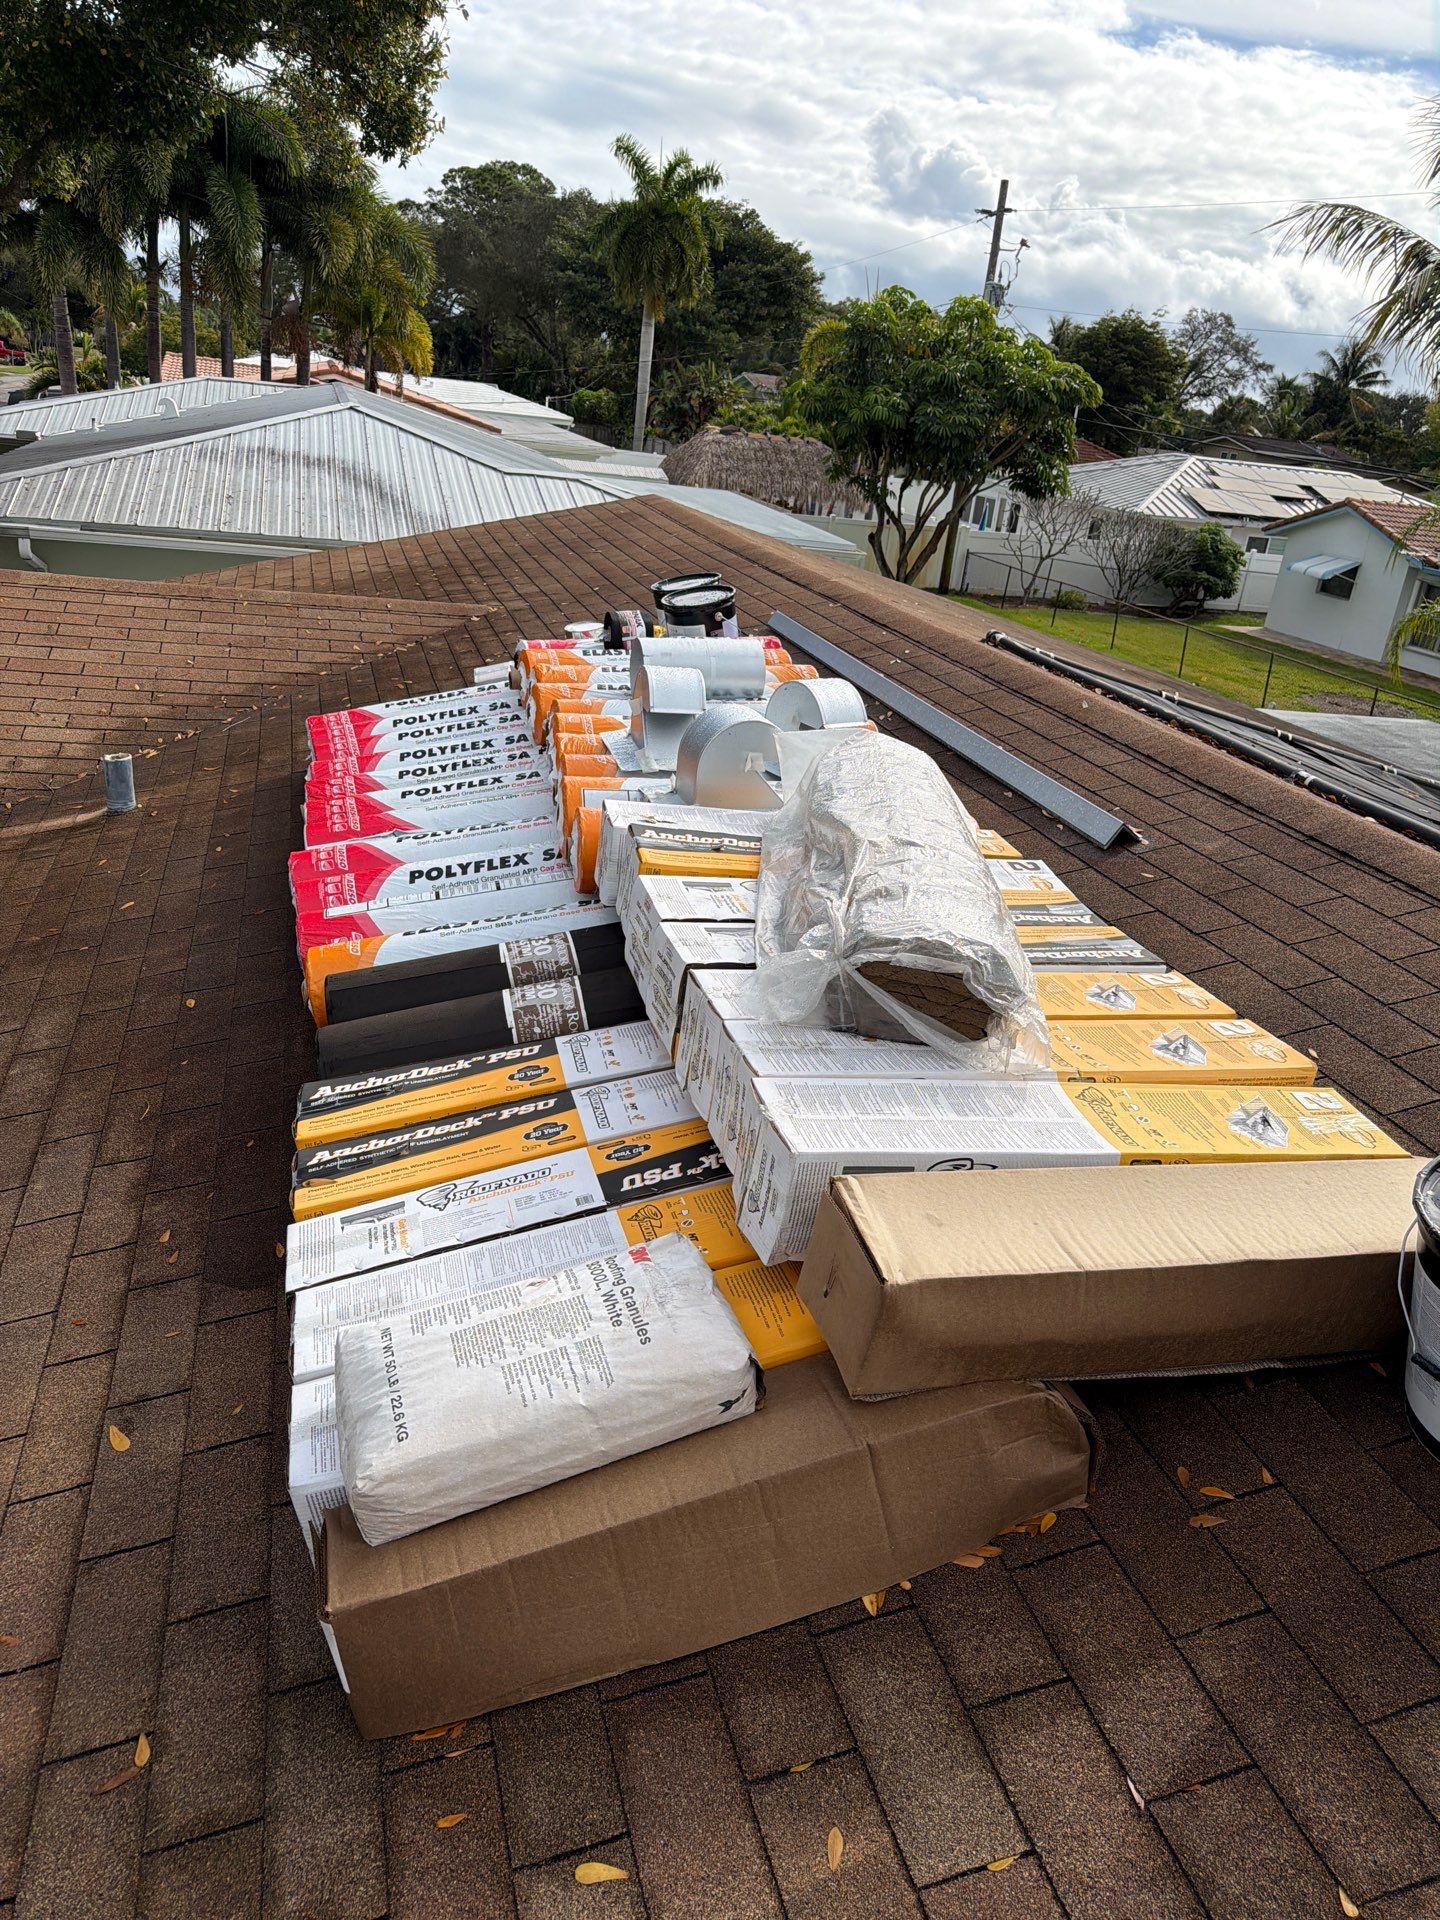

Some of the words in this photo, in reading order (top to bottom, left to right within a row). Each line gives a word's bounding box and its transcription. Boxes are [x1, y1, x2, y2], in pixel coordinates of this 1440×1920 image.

[393, 705, 479, 727] POLYFLEX
[489, 702, 511, 712] SA
[398, 719, 489, 740] POLYFLEX
[498, 713, 522, 723] SA
[399, 738, 494, 762] POLYFLEX
[505, 733, 529, 745] SA
[398, 756, 496, 779] POLYFLEX
[507, 751, 530, 761] SA
[401, 776, 503, 799] POLYFLEX
[515, 771, 541, 781] SA
[409, 852, 530, 884] POLYFLEX
[480, 871, 520, 885] Granulated
[522, 868, 538, 876] APP
[487, 1045, 542, 1064] PSU
[411, 1073, 459, 1084] UNDERLAYMENT
[514, 1072, 525, 1080] 20
[525, 1067, 545, 1076] Year
[498, 1098, 557, 1120] PSU
[529, 1131, 541, 1140] 20
[541, 1125, 564, 1135] Year
[359, 1148, 396, 1161] SYNTHETIC
[416, 1132, 469, 1146] UNDERLAYMENT
[550, 1170, 575, 1181] PSU
[621, 1162, 683, 1192] PSU
[628, 1247, 652, 1264] 3M
[601, 1290, 623, 1327] White
[620, 1286, 651, 1345] Granules
[381, 1327, 392, 1343] NET
[382, 1343, 394, 1359] WT
[385, 1359, 397, 1373] 50
[388, 1373, 399, 1388] LB
[391, 1395, 405, 1422] 22.6
[395, 1422, 409, 1443] KG
